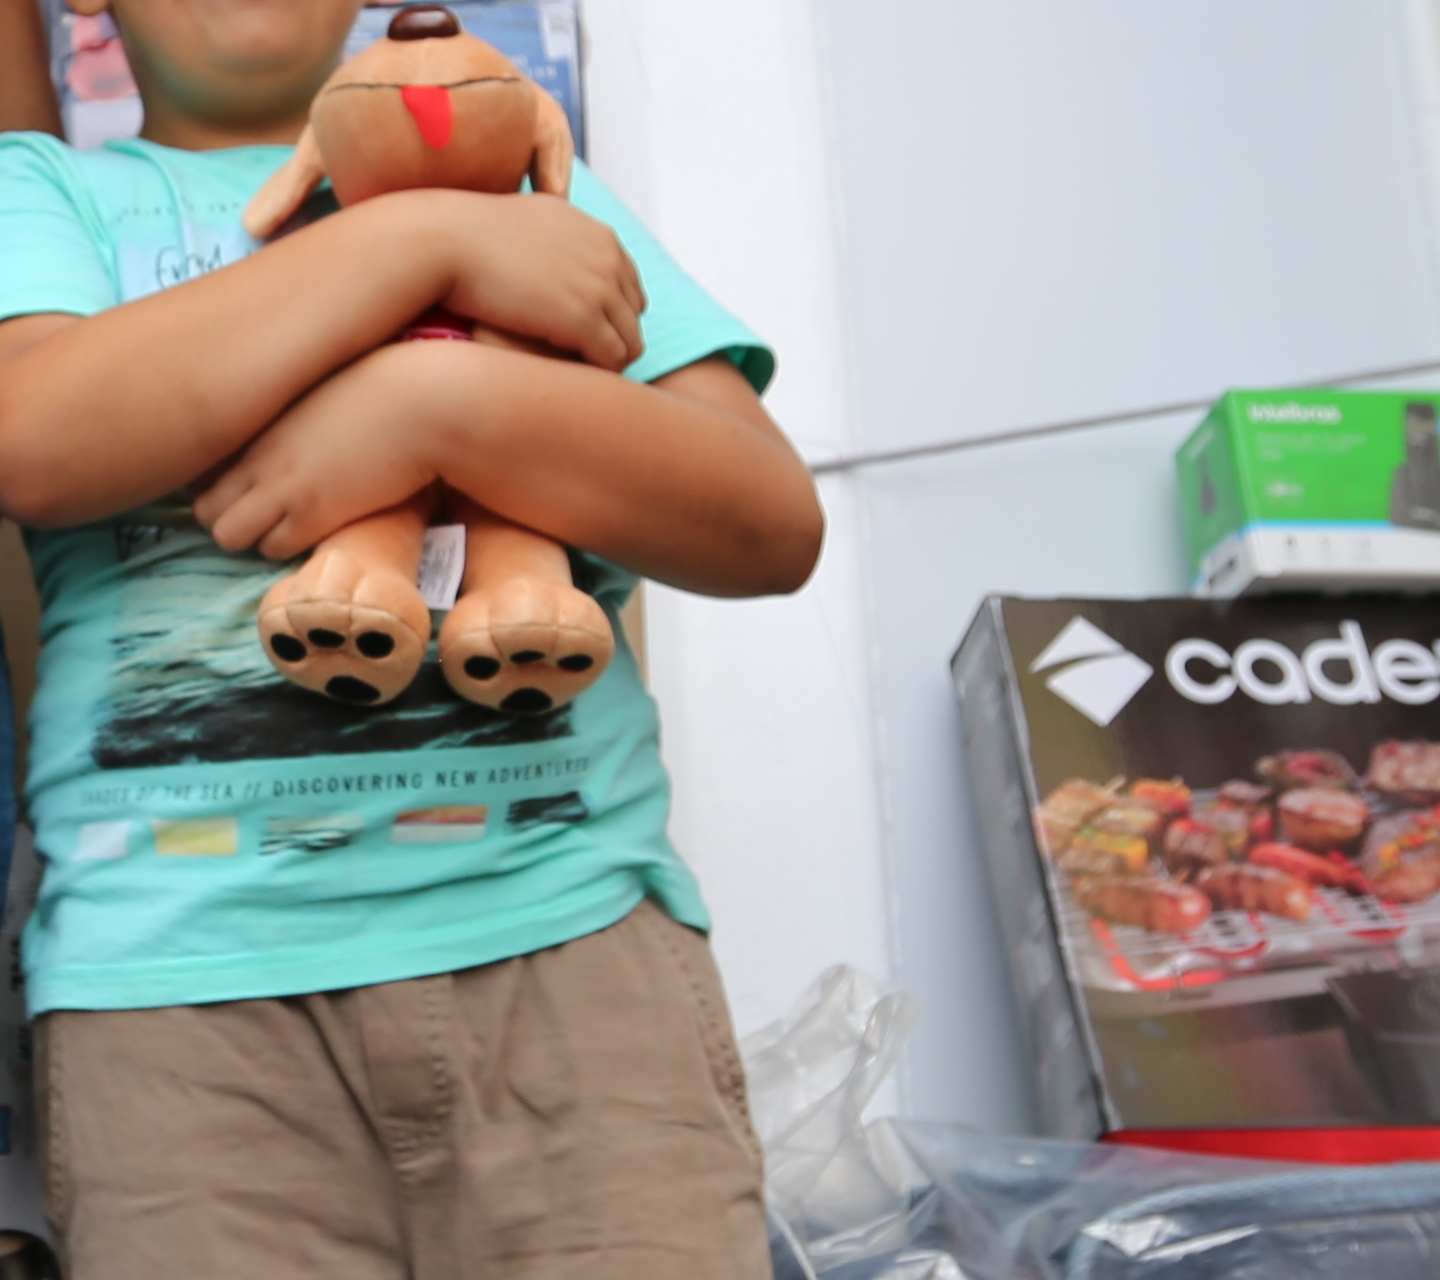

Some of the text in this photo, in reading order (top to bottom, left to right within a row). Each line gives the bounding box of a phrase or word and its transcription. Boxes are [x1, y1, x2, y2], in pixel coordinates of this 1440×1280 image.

[200, 781, 234, 801] SEA
[273, 772, 423, 798] DISCOVERING
[435, 770, 478, 789] NEW
[486, 756, 590, 785] ADVENTURES
